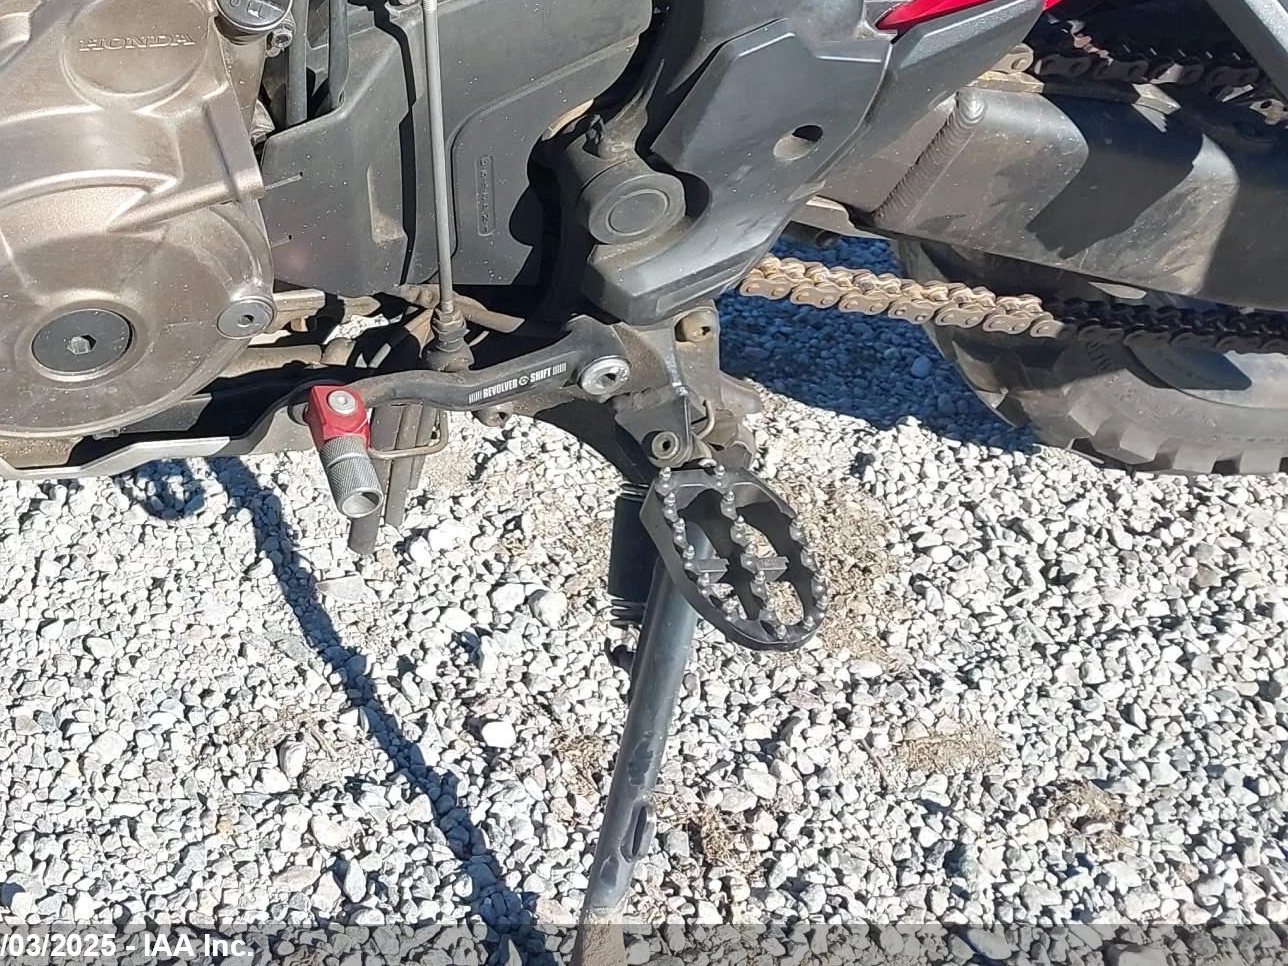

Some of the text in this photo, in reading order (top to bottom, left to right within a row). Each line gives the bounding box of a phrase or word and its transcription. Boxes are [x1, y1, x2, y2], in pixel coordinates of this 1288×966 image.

[79, 34, 196, 52] HONDA
[482, 366, 553, 399] REVOLVER SHIFT
